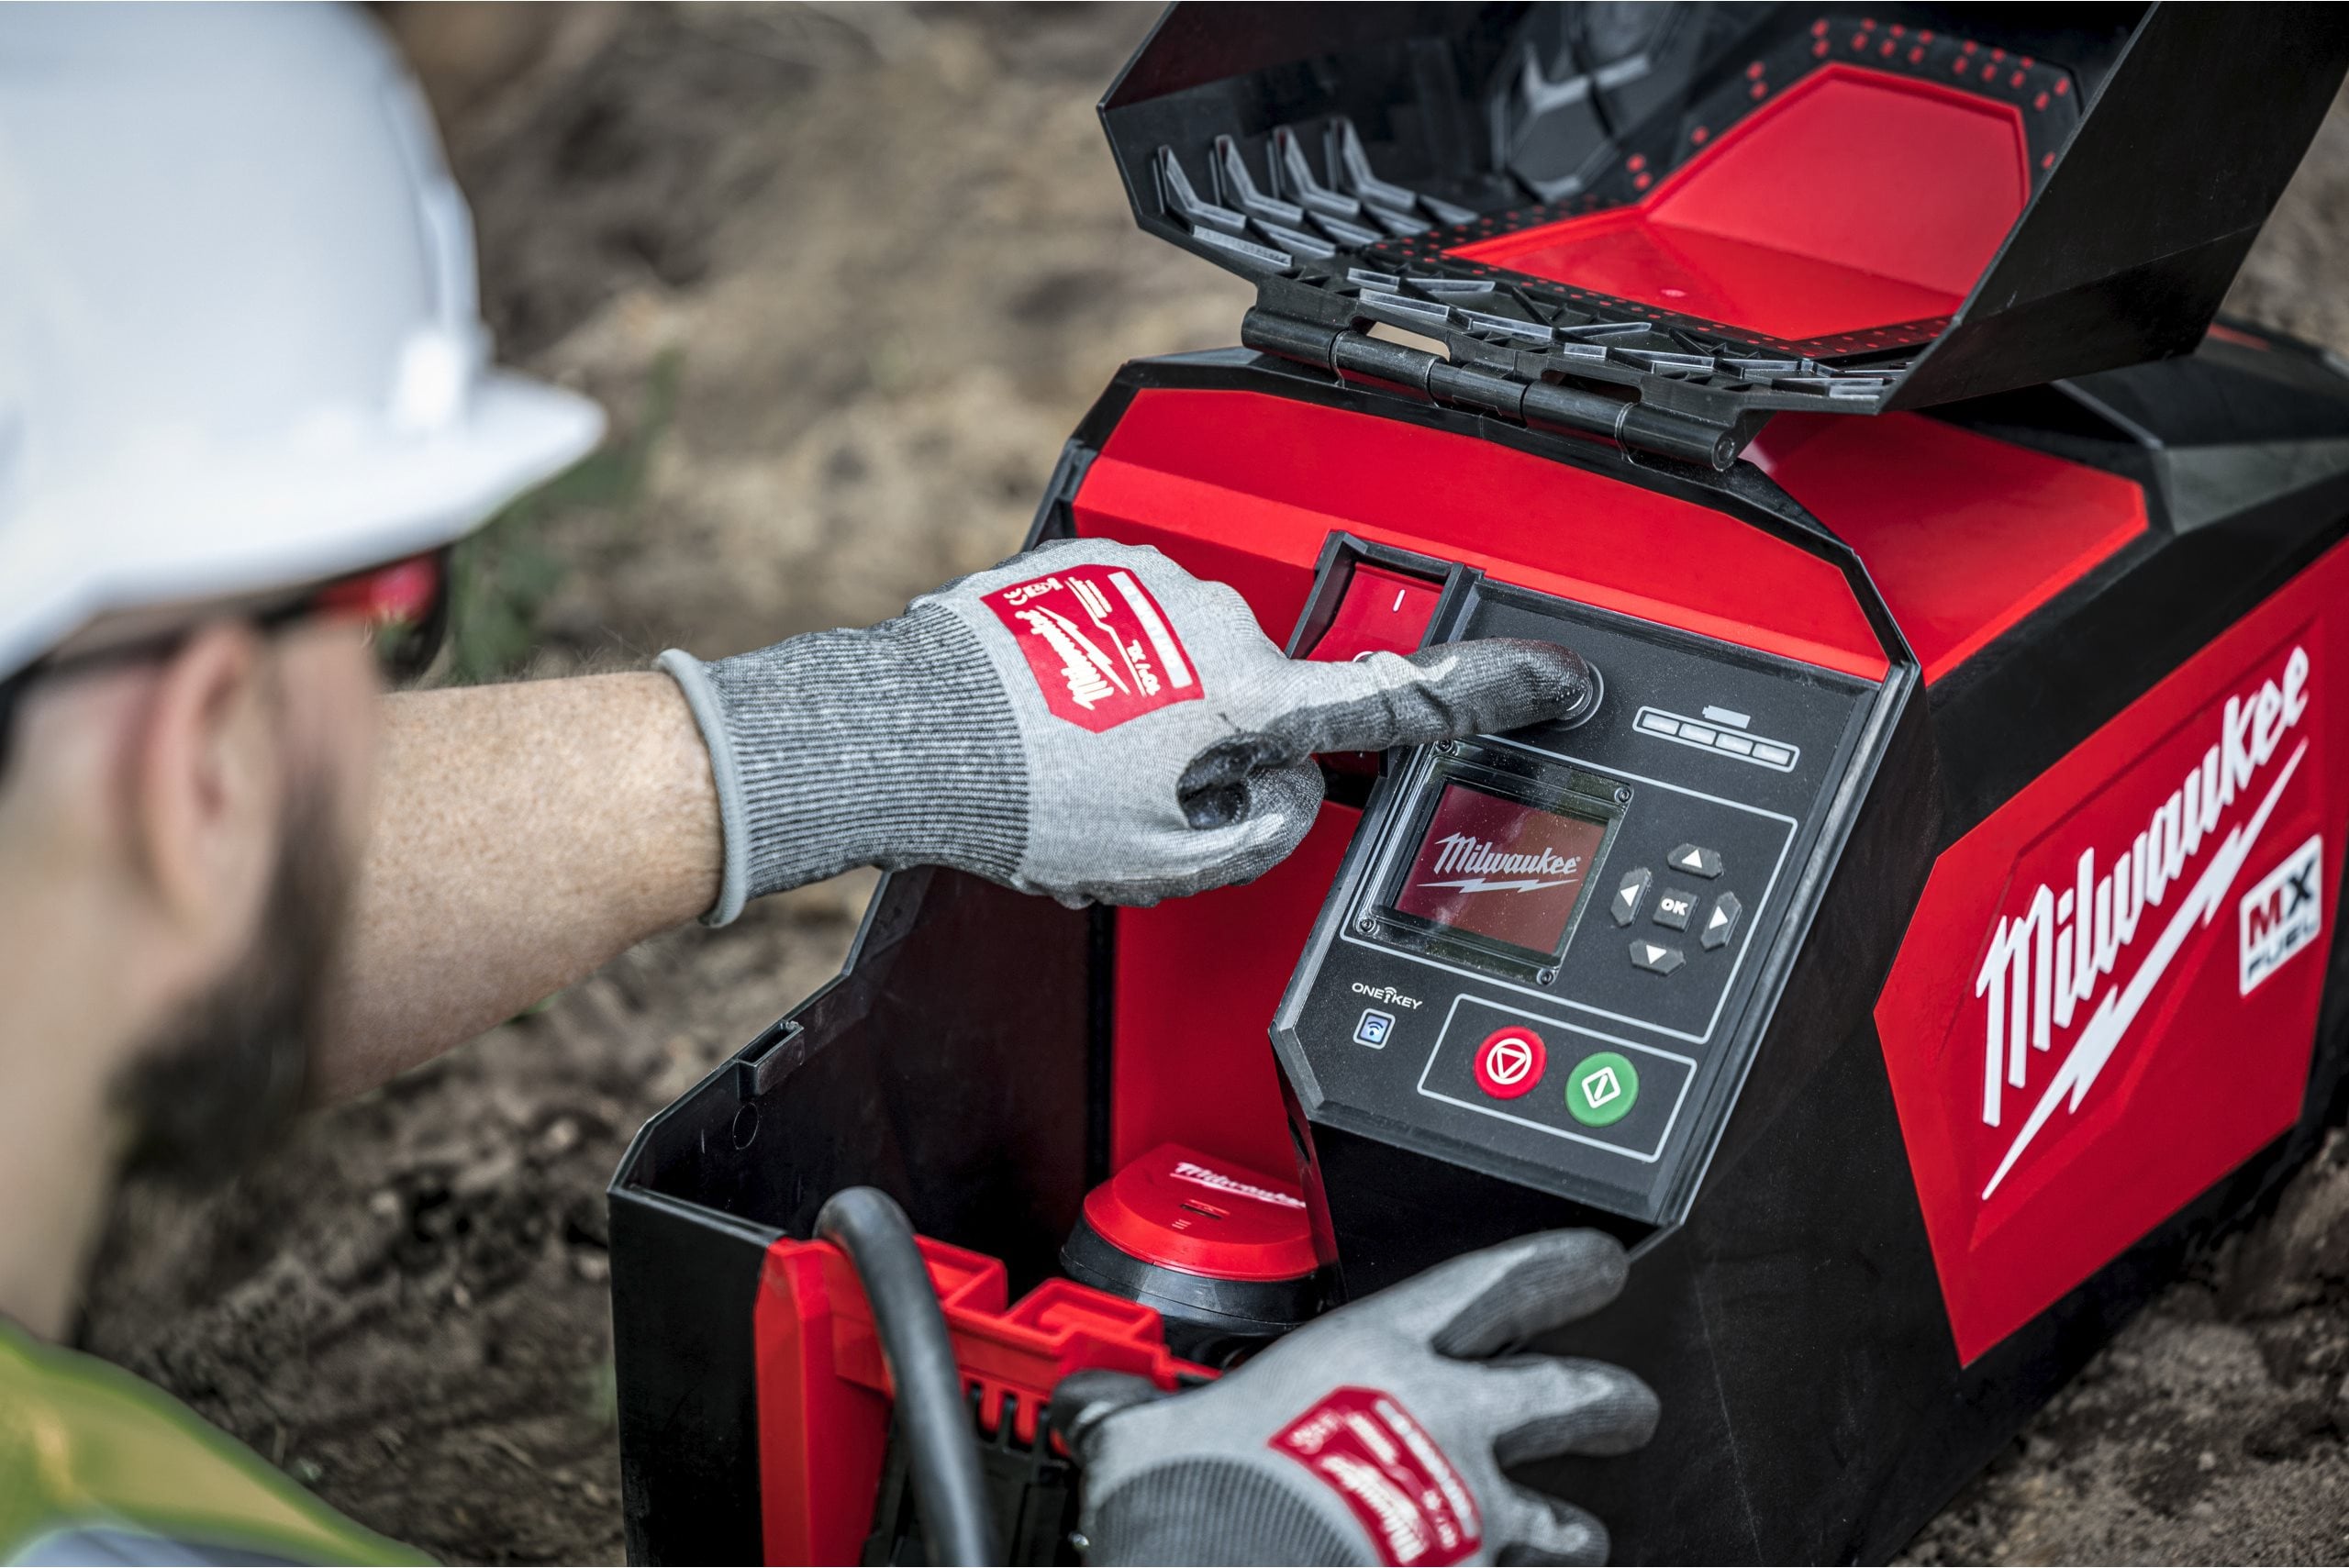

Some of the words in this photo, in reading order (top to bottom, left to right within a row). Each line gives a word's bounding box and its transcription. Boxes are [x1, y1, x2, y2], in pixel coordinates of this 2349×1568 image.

[1434, 831, 1578, 875] Milwaukee
[1661, 897, 1687, 916] OK
[1976, 645, 2310, 1128] Milwaukee
[2248, 856, 2317, 951] MX
[2247, 917, 2316, 981] FUEL
